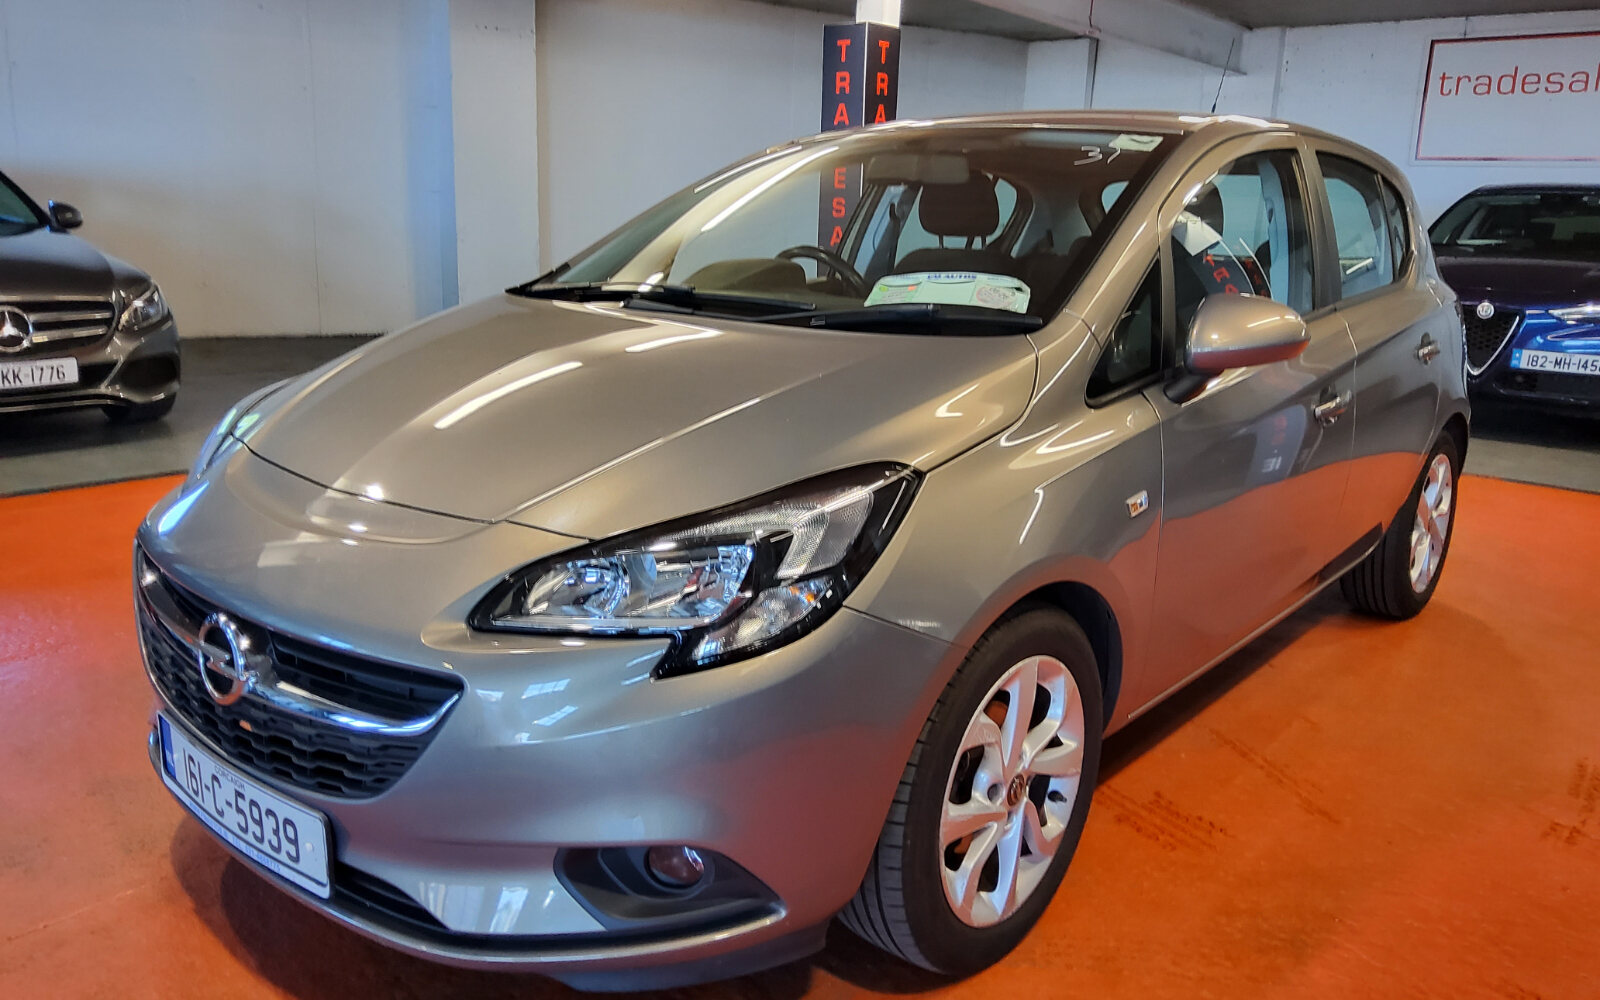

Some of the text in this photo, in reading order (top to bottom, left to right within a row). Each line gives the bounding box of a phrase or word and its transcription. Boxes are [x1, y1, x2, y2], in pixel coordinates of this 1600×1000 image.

[1439, 62, 1600, 97] tradesal
[1526, 354, 1600, 375] 182-MH-145
[182, 747, 300, 864] 161-C-5939
